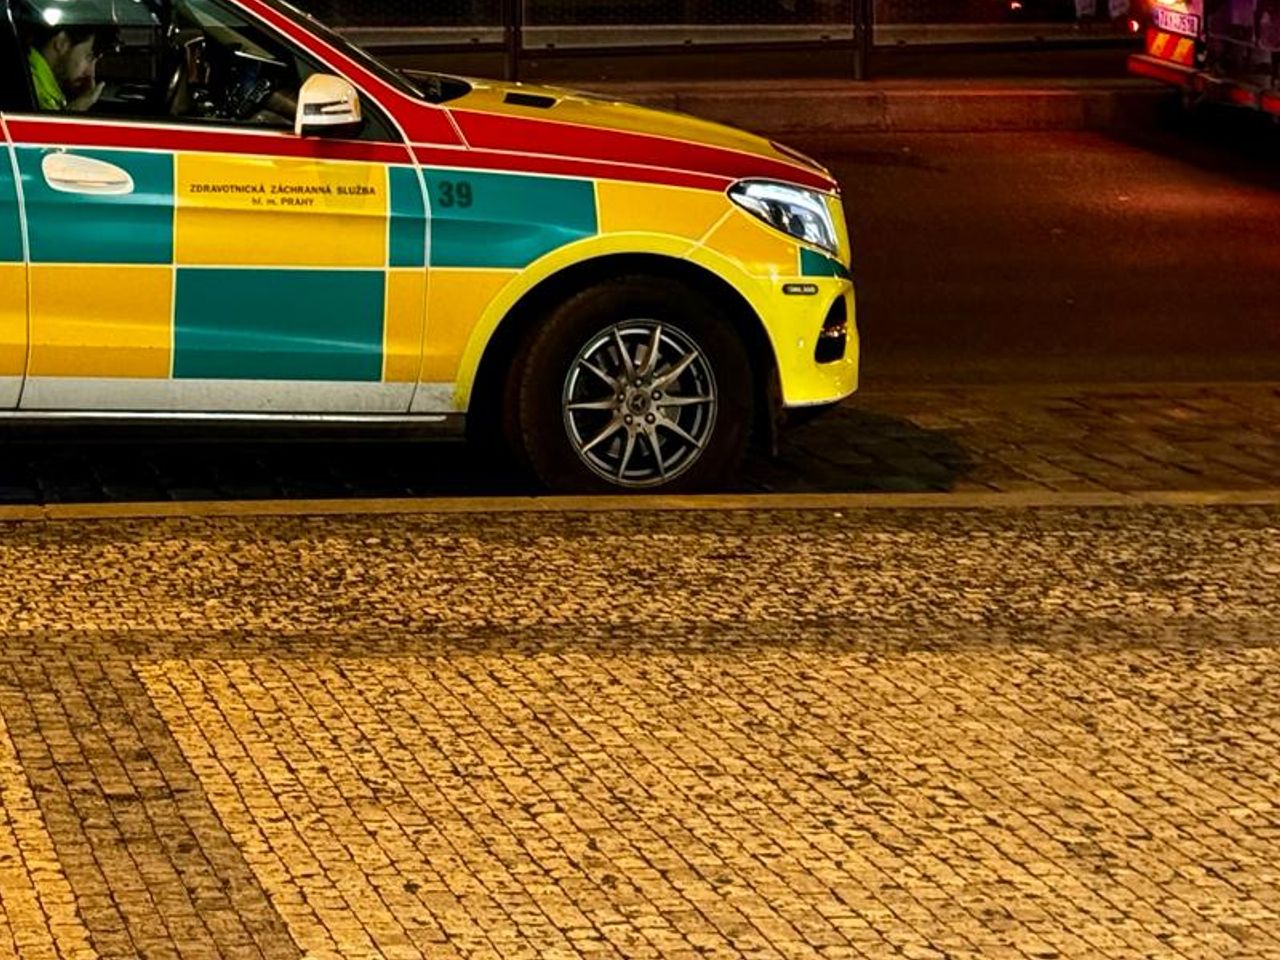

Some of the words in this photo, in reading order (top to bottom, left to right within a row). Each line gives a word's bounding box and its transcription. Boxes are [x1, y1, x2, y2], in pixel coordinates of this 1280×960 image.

[337, 185, 377, 196] SLUŽBA
[438, 180, 473, 208] 39
[280, 196, 314, 207] PRAHY
